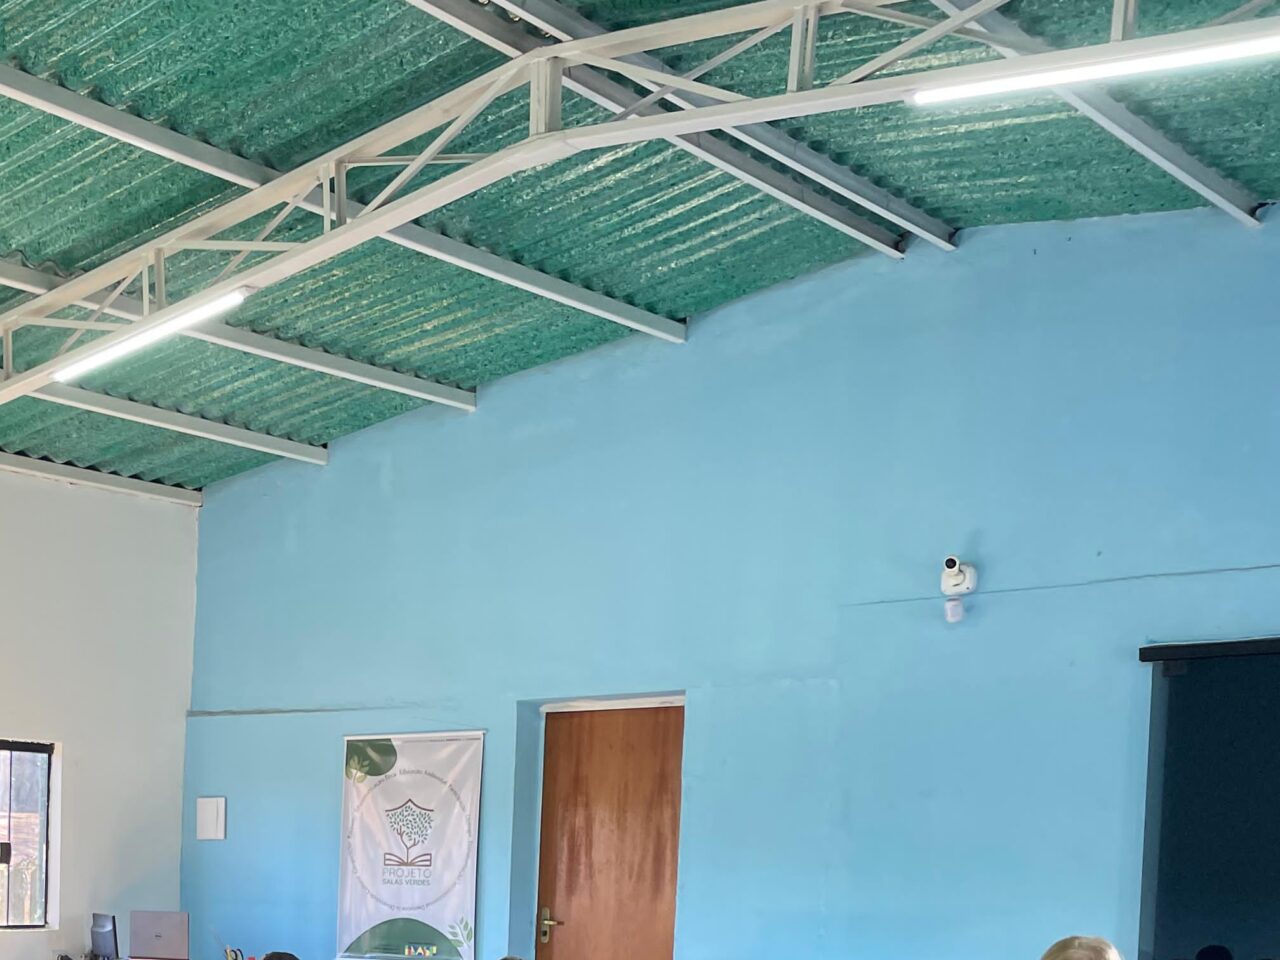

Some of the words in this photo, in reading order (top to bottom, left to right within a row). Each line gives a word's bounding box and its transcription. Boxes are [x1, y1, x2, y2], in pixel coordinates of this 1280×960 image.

[382, 867, 432, 879] PROJETO
[382, 878, 403, 886] SALAS
[405, 879, 431, 887] VERDES
